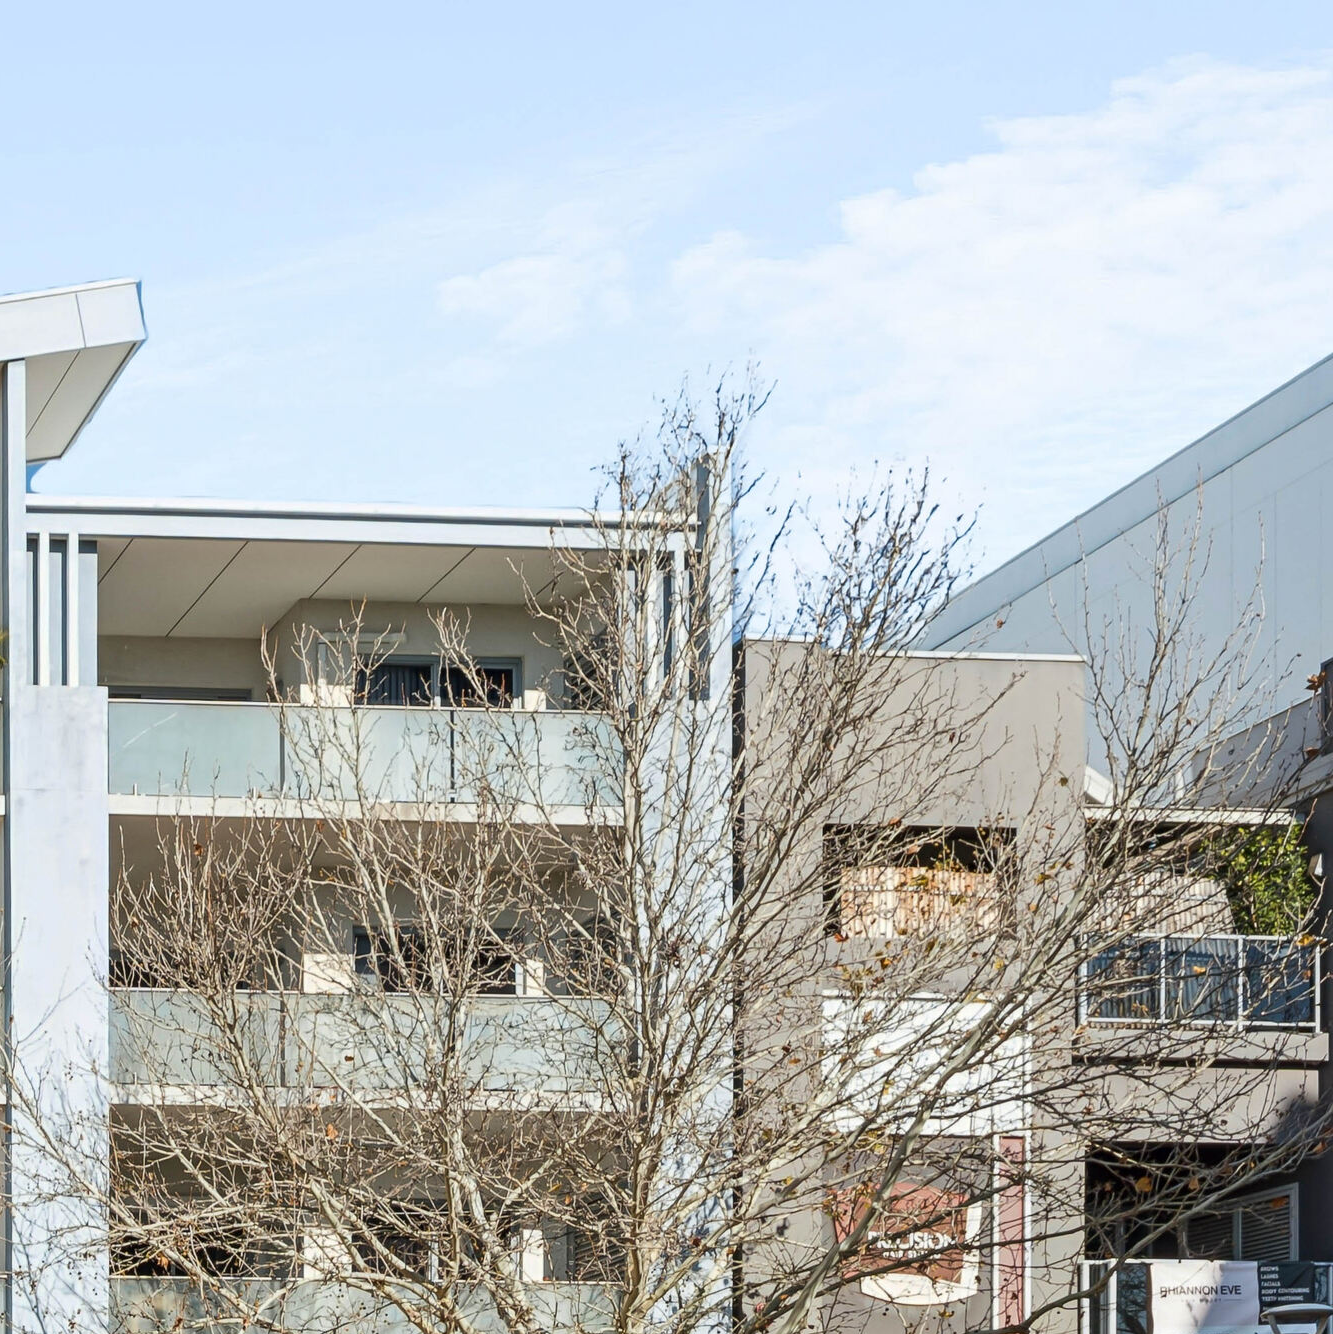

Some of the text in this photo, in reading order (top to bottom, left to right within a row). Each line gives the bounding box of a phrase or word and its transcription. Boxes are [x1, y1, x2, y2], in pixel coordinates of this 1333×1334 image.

[867, 1231, 956, 1250] PRCISION
[1160, 1285, 1242, 1296] RHIANNON EVE
